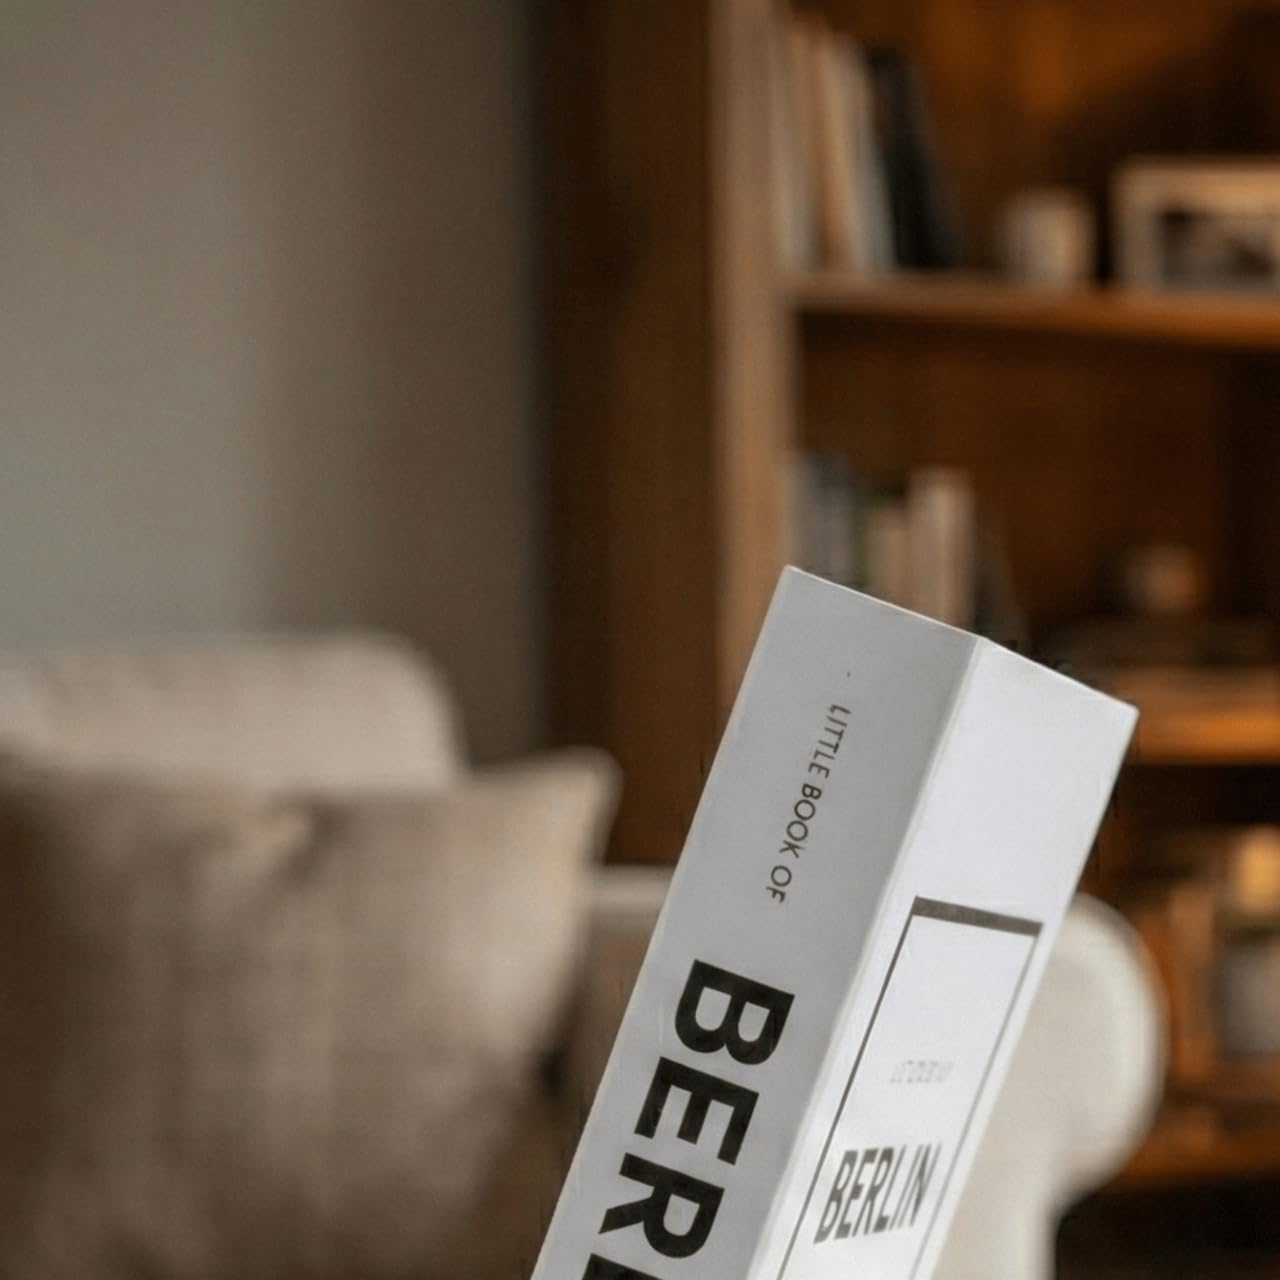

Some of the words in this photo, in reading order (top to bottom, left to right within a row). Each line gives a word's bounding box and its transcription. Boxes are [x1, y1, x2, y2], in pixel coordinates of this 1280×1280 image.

[807, 703, 852, 780] LITTLE
[778, 782, 823, 862] BOOK
[764, 863, 794, 905] OF
[813, 1141, 942, 1244] BERLIN
